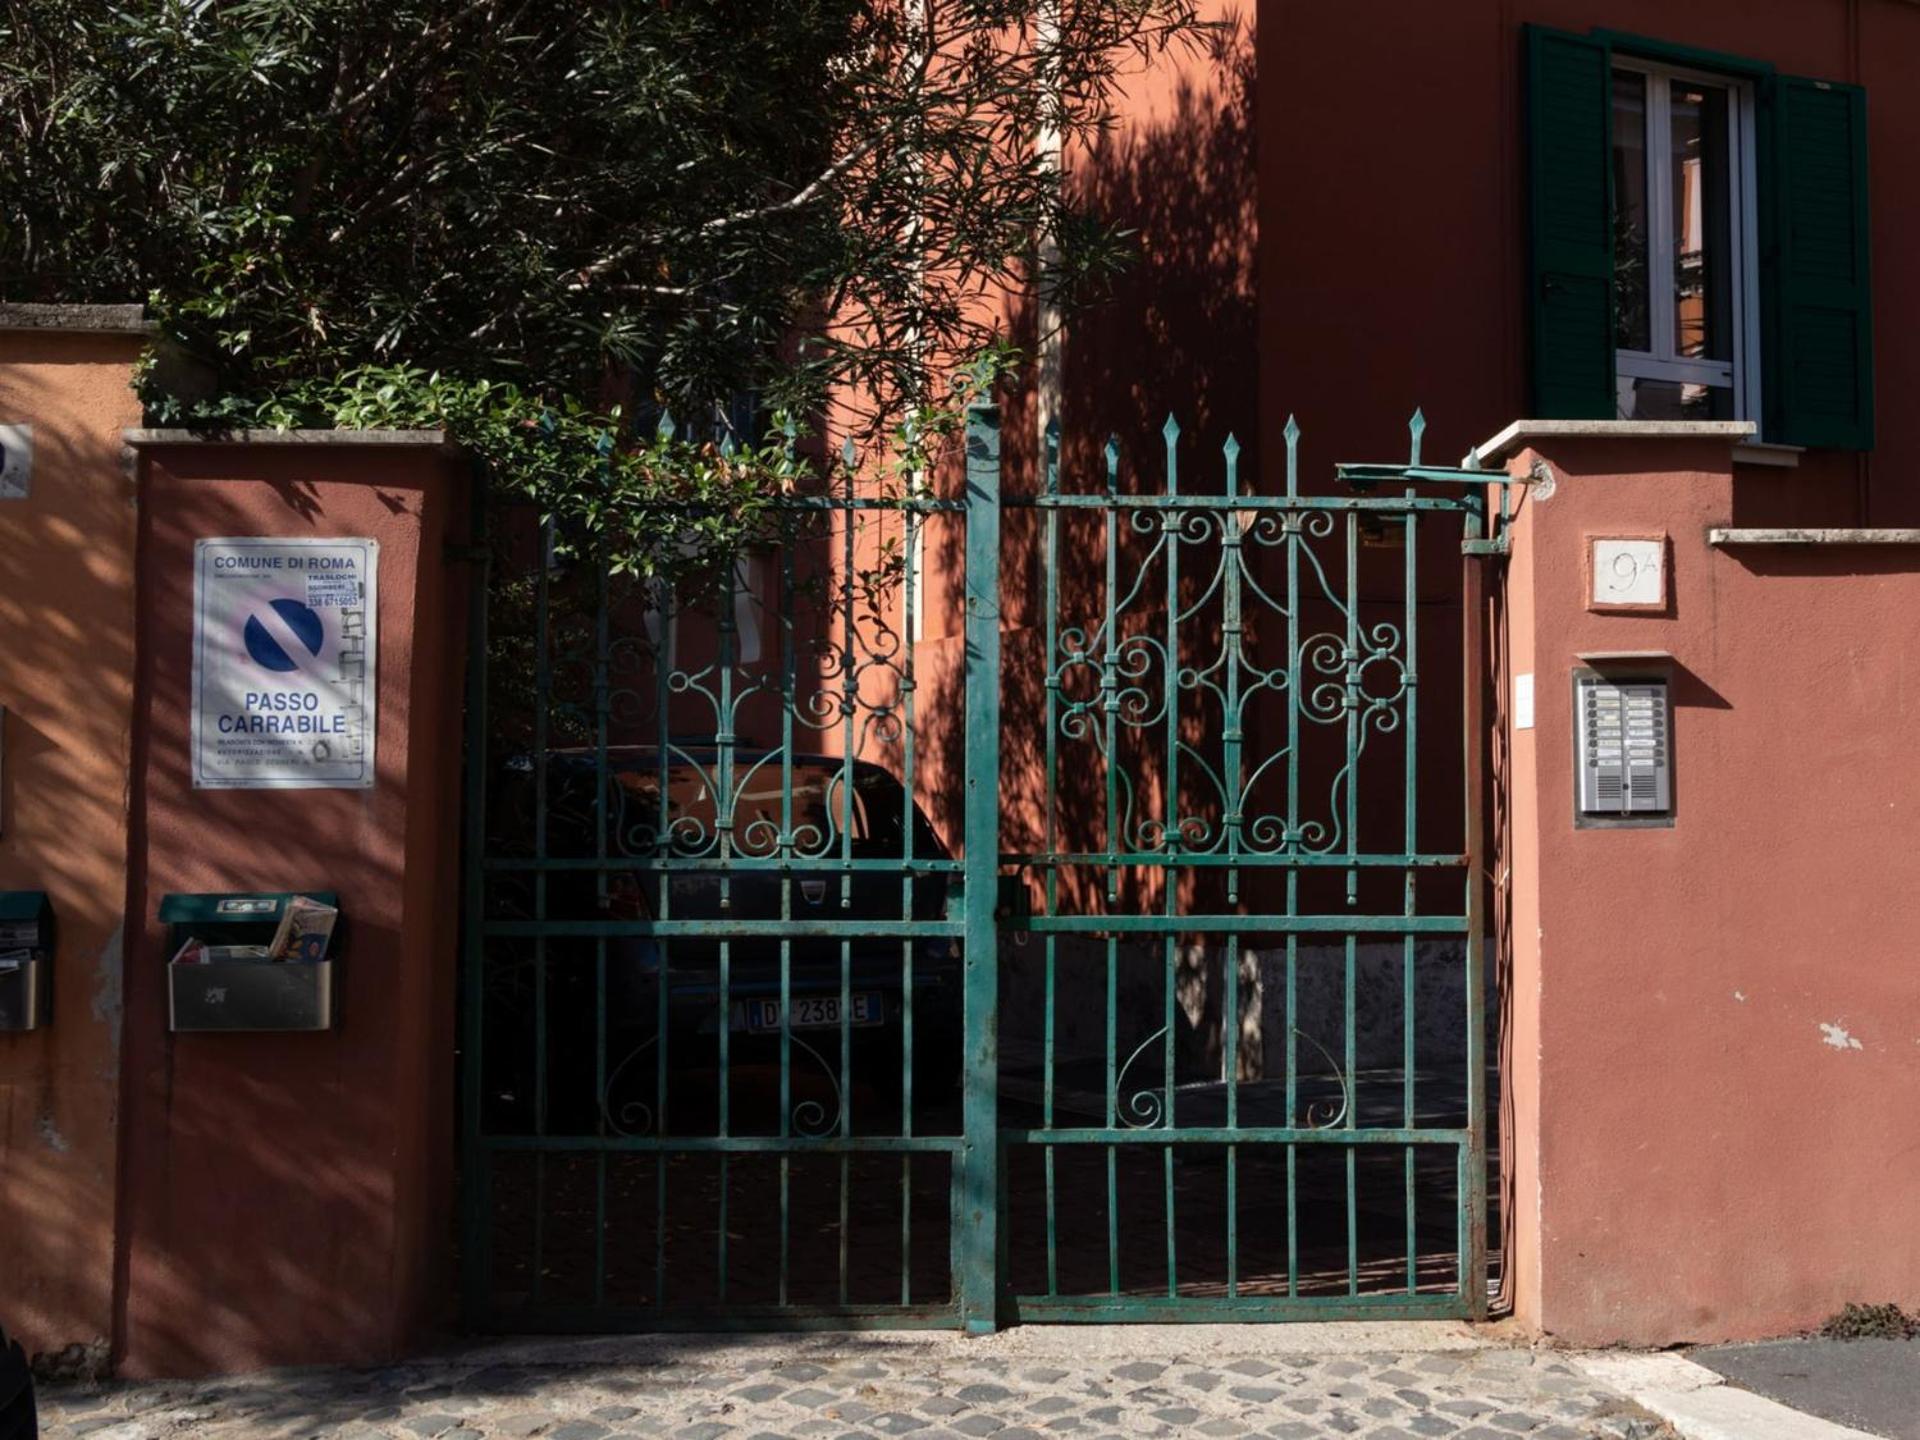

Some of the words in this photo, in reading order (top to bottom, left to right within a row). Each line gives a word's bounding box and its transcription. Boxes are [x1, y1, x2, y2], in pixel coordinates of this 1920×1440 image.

[214, 556, 282, 569] COMUNE
[288, 556, 304, 569] DI
[308, 556, 356, 569] ROMA
[245, 692, 319, 711] PASSO
[218, 714, 346, 733] CARRABILE
